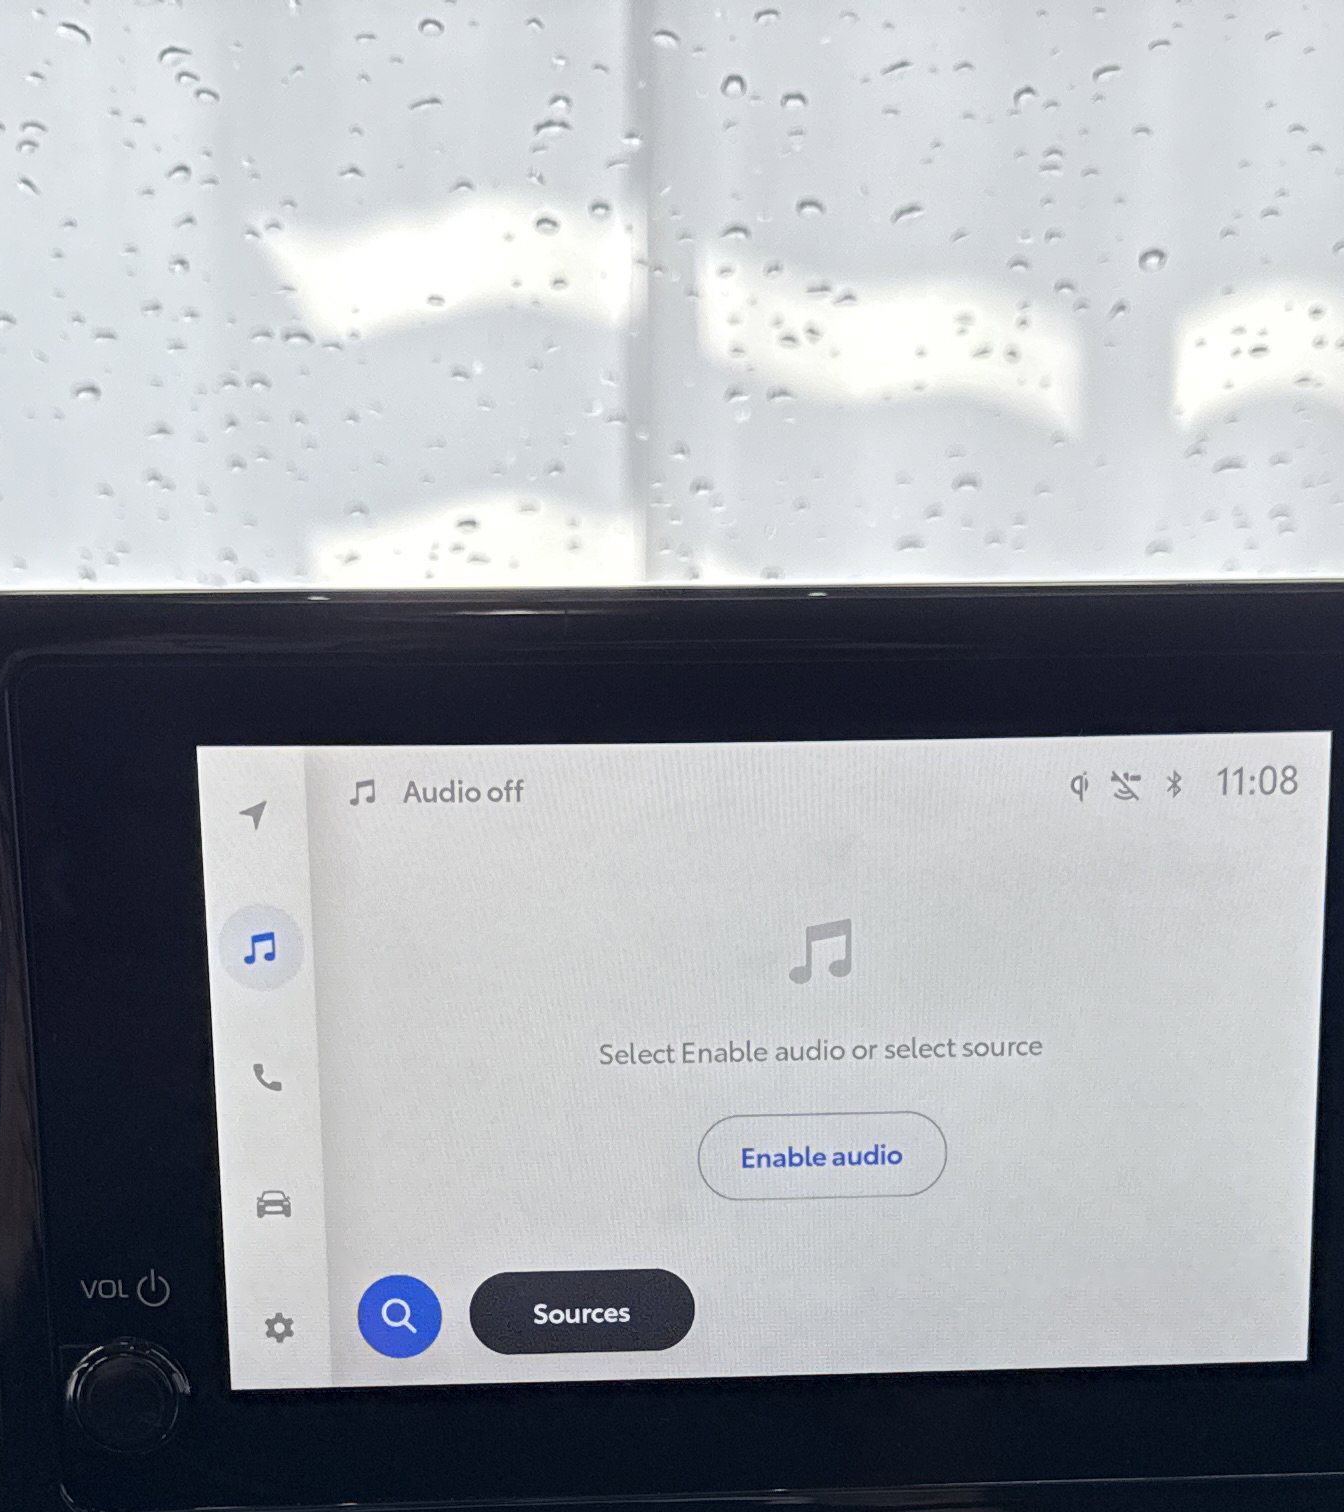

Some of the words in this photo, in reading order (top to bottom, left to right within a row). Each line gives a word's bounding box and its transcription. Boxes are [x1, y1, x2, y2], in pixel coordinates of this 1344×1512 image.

[403, 779, 481, 803] Audio
[487, 779, 524, 803] off
[1216, 764, 1299, 796] 11:08
[599, 1042, 676, 1065] Select
[682, 1039, 768, 1064] Enable
[775, 1038, 845, 1062] audio
[852, 1044, 878, 1060] or
[884, 1036, 957, 1059] select
[961, 1040, 1044, 1058] source
[741, 1145, 827, 1169] Enable
[832, 1143, 903, 1166] audio
[80, 1279, 129, 1299] VOL
[533, 1303, 631, 1325] Sources
